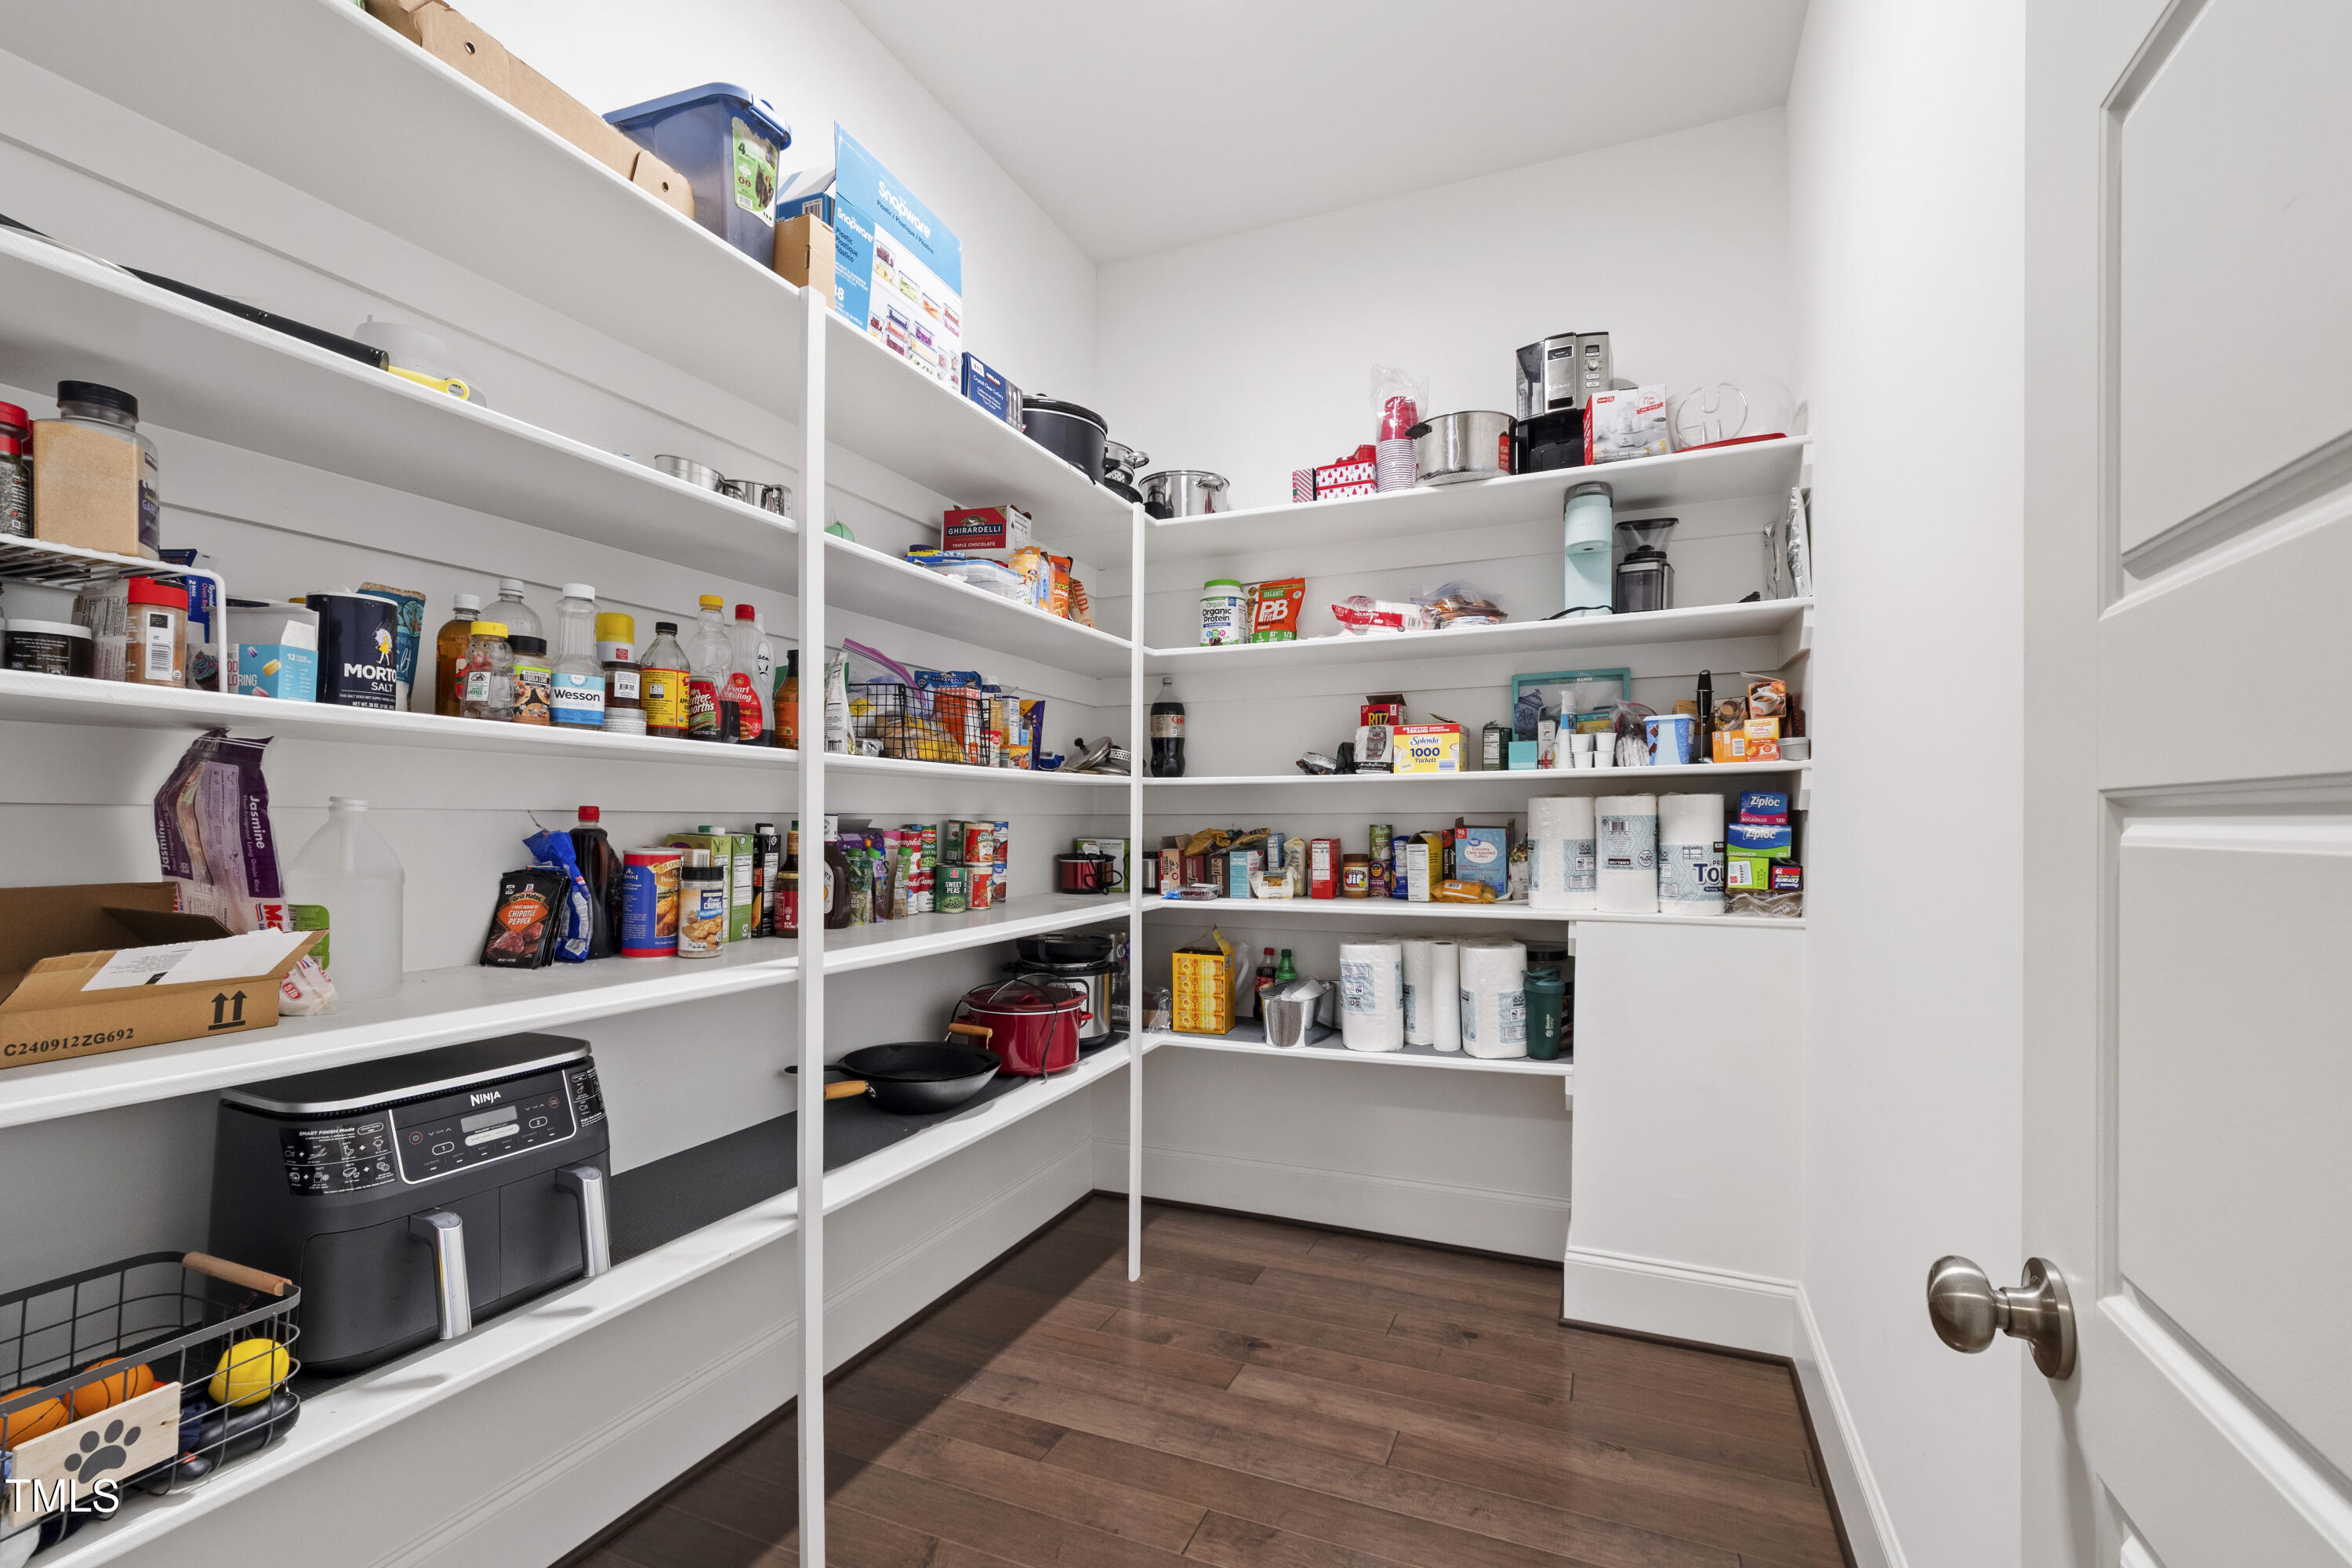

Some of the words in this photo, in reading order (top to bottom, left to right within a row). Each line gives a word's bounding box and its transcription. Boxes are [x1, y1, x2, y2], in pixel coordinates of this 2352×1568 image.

[877, 200, 891, 216] Plastic
[879, 180, 931, 238] Snapware
[837, 207, 874, 242] Snapware
[836, 227, 852, 245] Plastic
[836, 236, 858, 256] Plastique
[949, 526, 1001, 535] GHIRARDELLI
[1203, 608, 1232, 616] Organic
[1258, 599, 1288, 622] PB
[344, 663, 397, 682] MORTO
[371, 682, 393, 692] SALT
[554, 690, 600, 702] Wesson
[690, 694, 712, 705] utter-
[690, 702, 714, 713] orth's
[1368, 713, 1389, 726] RITZ
[1410, 736, 1439, 746] Splenda
[1410, 747, 1440, 757] 1000
[1750, 796, 1780, 808] Ziploc
[250, 795, 265, 849] Jasmine
[1746, 829, 1777, 840] Ziploc
[158, 820, 171, 870] Jasmine
[513, 893, 524, 902] Grill
[525, 893, 541, 902] Mates
[470, 1091, 501, 1107] NINJA
